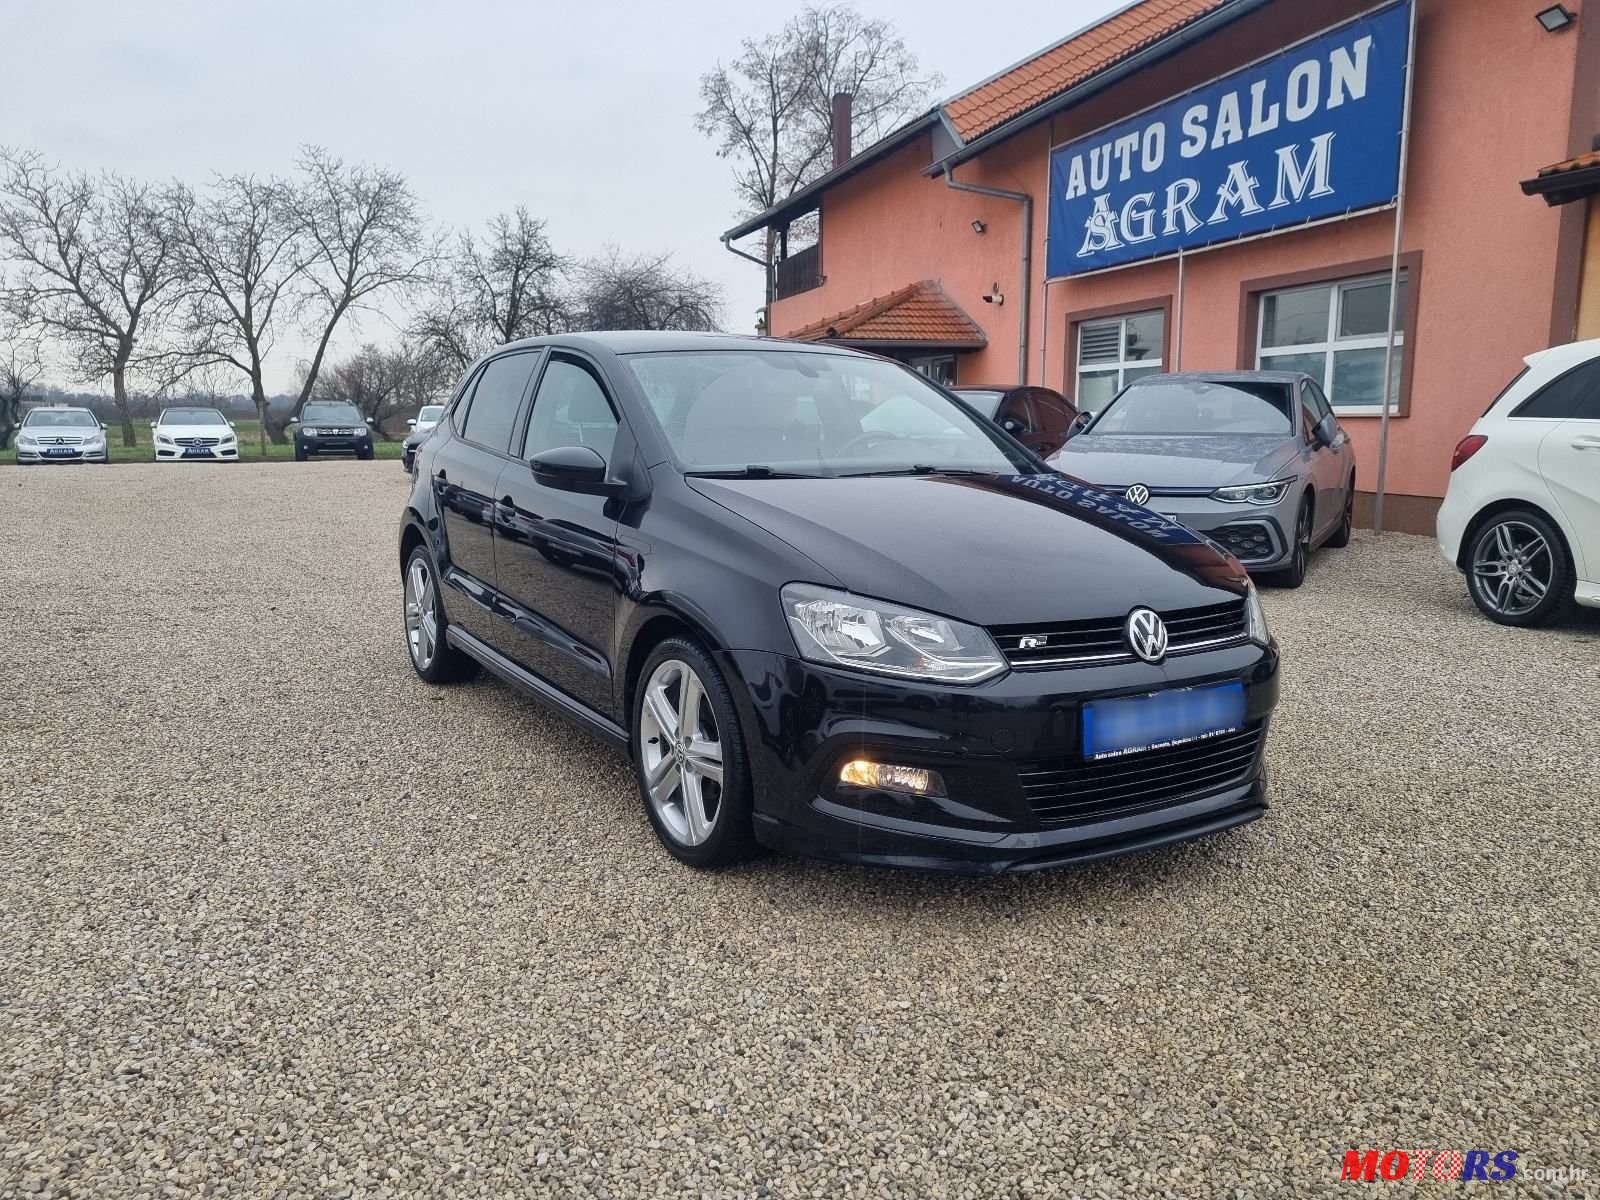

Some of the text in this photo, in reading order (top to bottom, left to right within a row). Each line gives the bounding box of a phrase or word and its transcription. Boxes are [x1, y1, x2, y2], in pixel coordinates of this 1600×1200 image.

[1065, 35, 1372, 200] AUTO SALON
[1076, 132, 1337, 258] AGRAM
